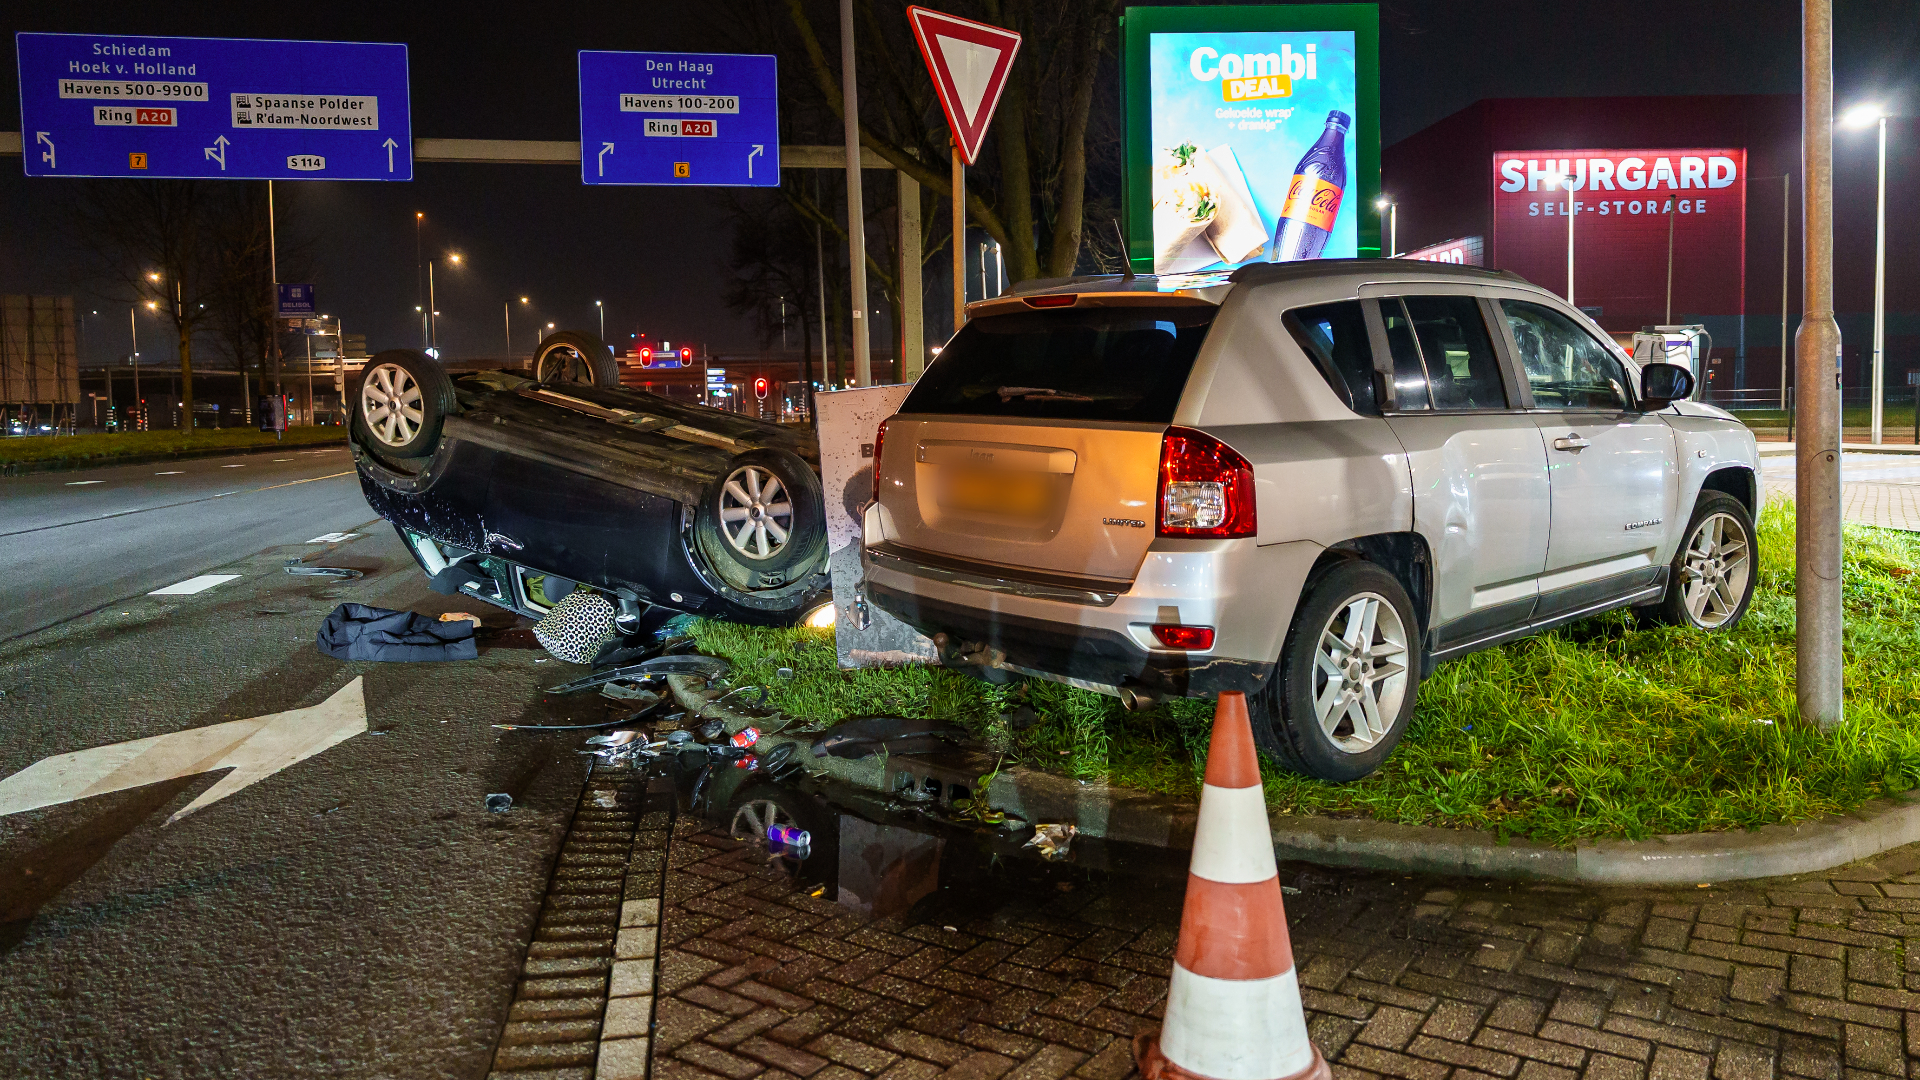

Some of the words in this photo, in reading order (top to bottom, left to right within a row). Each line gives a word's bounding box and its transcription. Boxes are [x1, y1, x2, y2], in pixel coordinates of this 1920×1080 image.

[93, 43, 171, 57] Schiedam
[69, 60, 111, 74] Hoek
[115, 64, 129, 75] v.
[134, 62, 197, 76] Holland
[646, 60, 673, 71] Den
[678, 60, 713, 75] Haag
[1189, 43, 1317, 82] Combi
[64, 82, 121, 95] Havens
[125, 84, 203, 97] 500-9900
[652, 78, 706, 89] Utrecht
[1230, 77, 1285, 99] DEAL
[255, 96, 315, 110] Spaanse
[319, 98, 365, 110] Polder
[624, 96, 673, 109] Havens
[677, 97, 735, 109] 100-200
[99, 109, 132, 125] Ring
[140, 112, 169, 122] A20
[256, 113, 373, 126] R'dam-Noordwest
[1215, 107, 1263, 119] Gekoelde
[648, 121, 678, 135] Ring
[684, 124, 711, 134] A20
[135, 155, 142, 166] 7
[291, 158, 298, 167] S
[300, 158, 321, 167] 114
[678, 165, 686, 175] 6
[1499, 156, 1737, 193] SHURGARD
[1528, 199, 1707, 217] SELF-STORAGE
[1102, 517, 1146, 528] LIMITED
[1624, 517, 1663, 530] COMPASS
